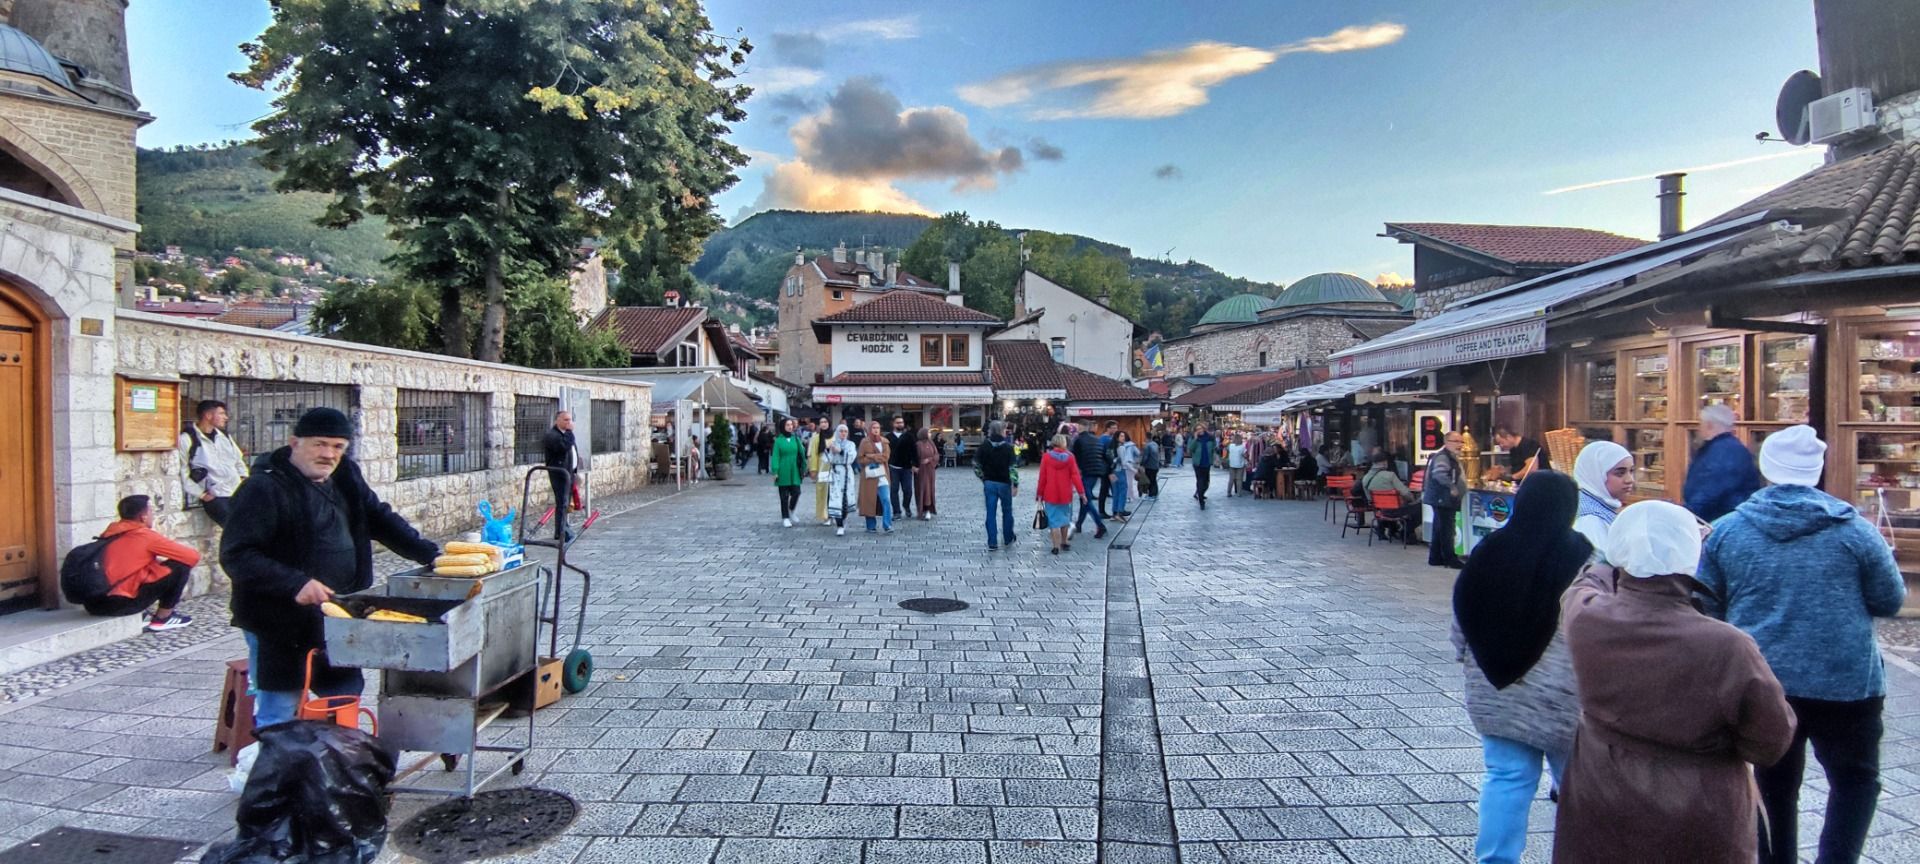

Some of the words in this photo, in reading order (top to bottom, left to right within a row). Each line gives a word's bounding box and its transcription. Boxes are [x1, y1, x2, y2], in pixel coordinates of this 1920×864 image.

[902, 344, 909, 353] 2
[1456, 342, 1478, 353] COFFEE
[1479, 339, 1492, 349] AND
[1494, 338, 1506, 347] TEA
[1508, 333, 1530, 345] KAFFA
[1421, 416, 1445, 450] B
